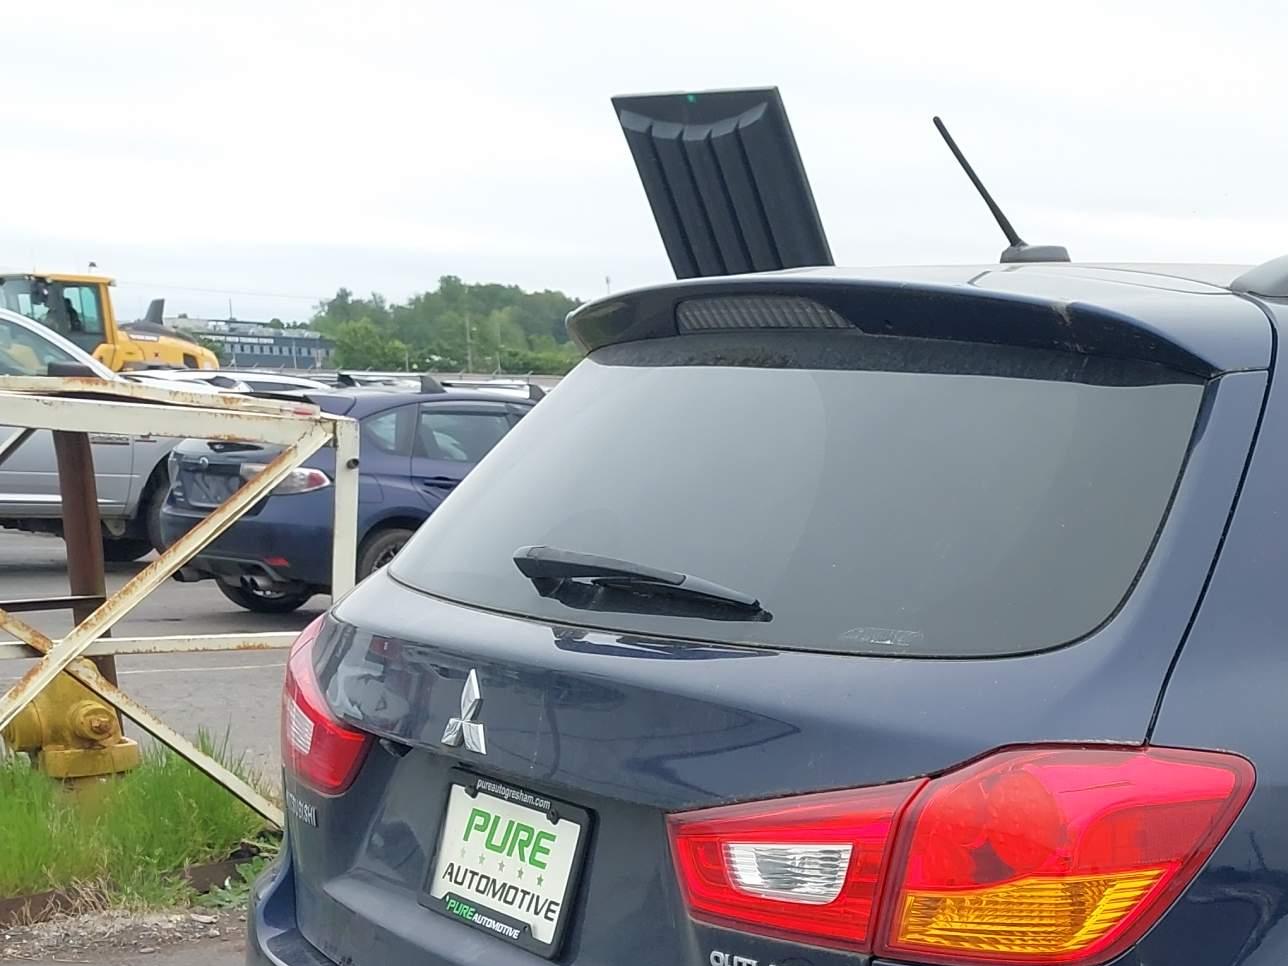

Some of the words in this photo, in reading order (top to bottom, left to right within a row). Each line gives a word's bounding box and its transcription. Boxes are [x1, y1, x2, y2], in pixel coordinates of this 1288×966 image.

[476, 779, 551, 810] pureautogresham.com
[462, 808, 557, 870] PURE
[442, 862, 560, 921] AUTOMOTIVE
